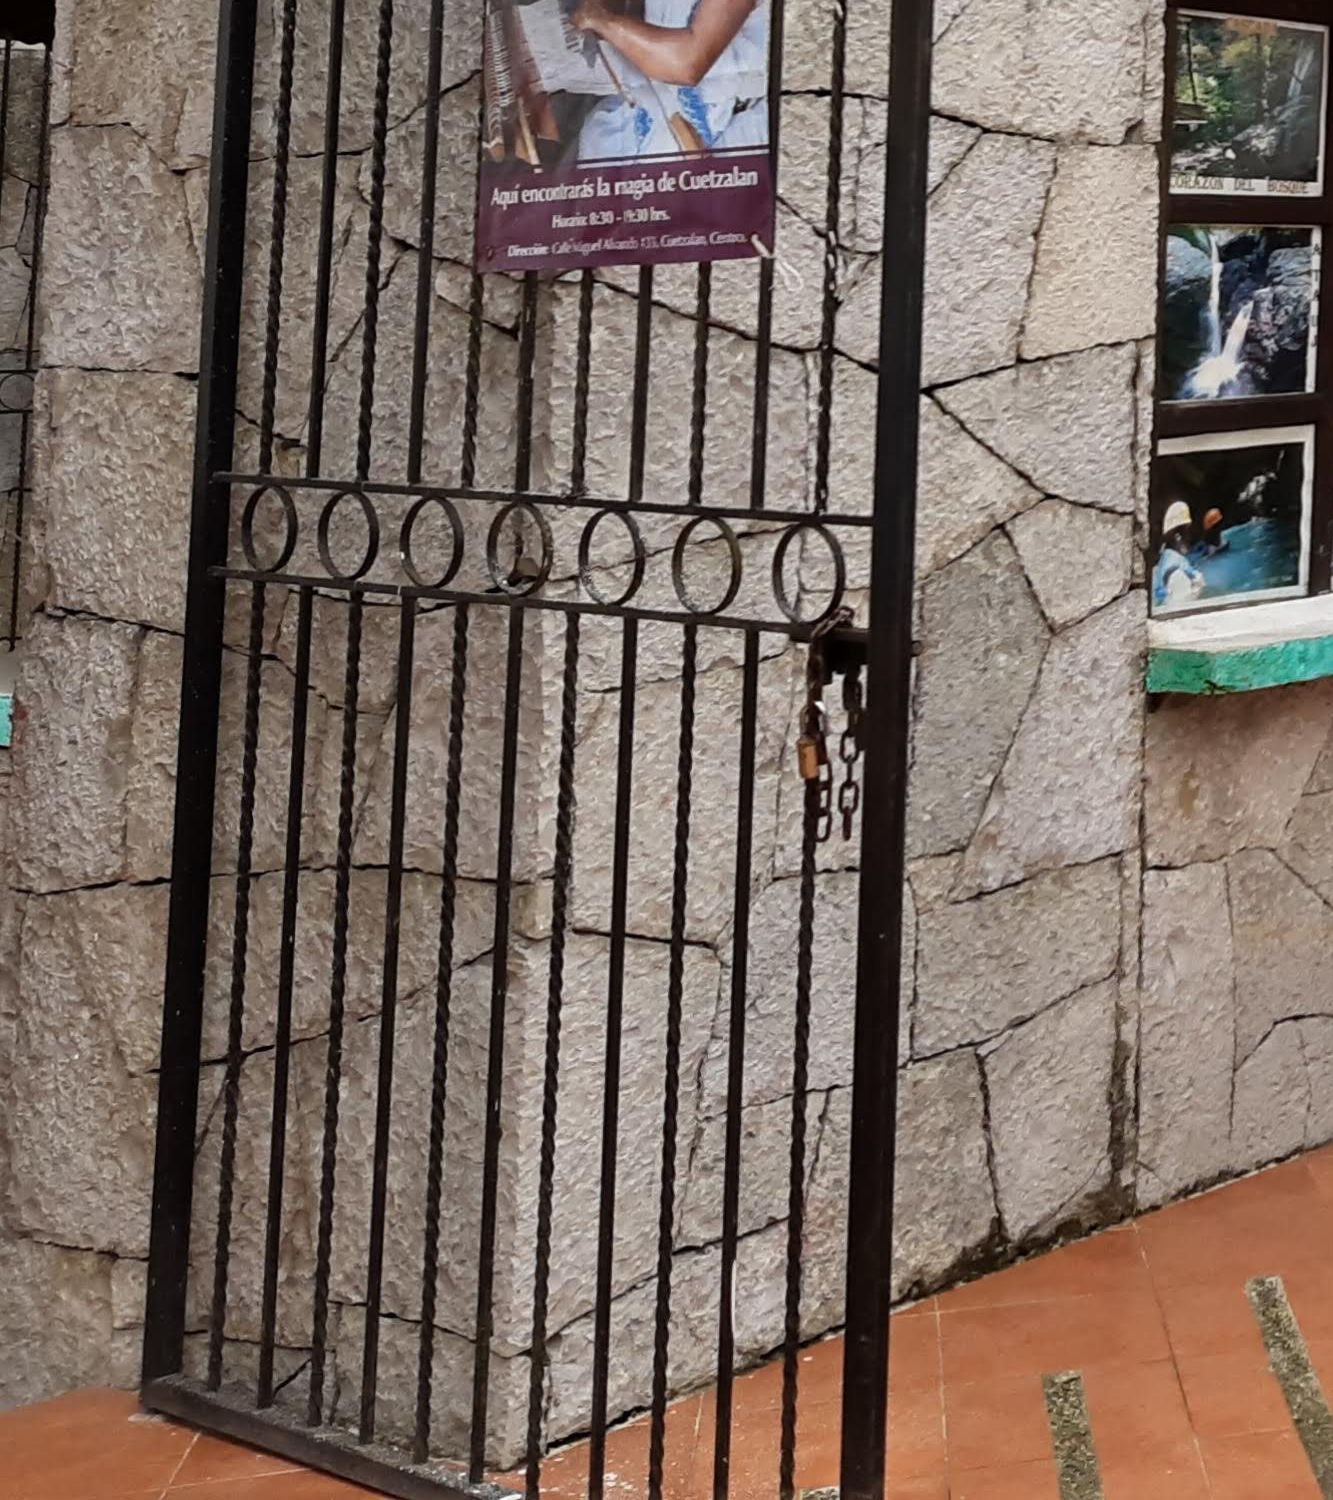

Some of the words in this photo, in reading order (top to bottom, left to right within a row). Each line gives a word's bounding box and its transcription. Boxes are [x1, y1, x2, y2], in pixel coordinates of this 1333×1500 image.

[490, 183, 521, 211] Aquí
[521, 178, 595, 203] encontrarás
[597, 176, 611, 198] la
[614, 173, 655, 200] magia
[657, 171, 676, 192] de
[678, 165, 758, 191] Cuetzalan
